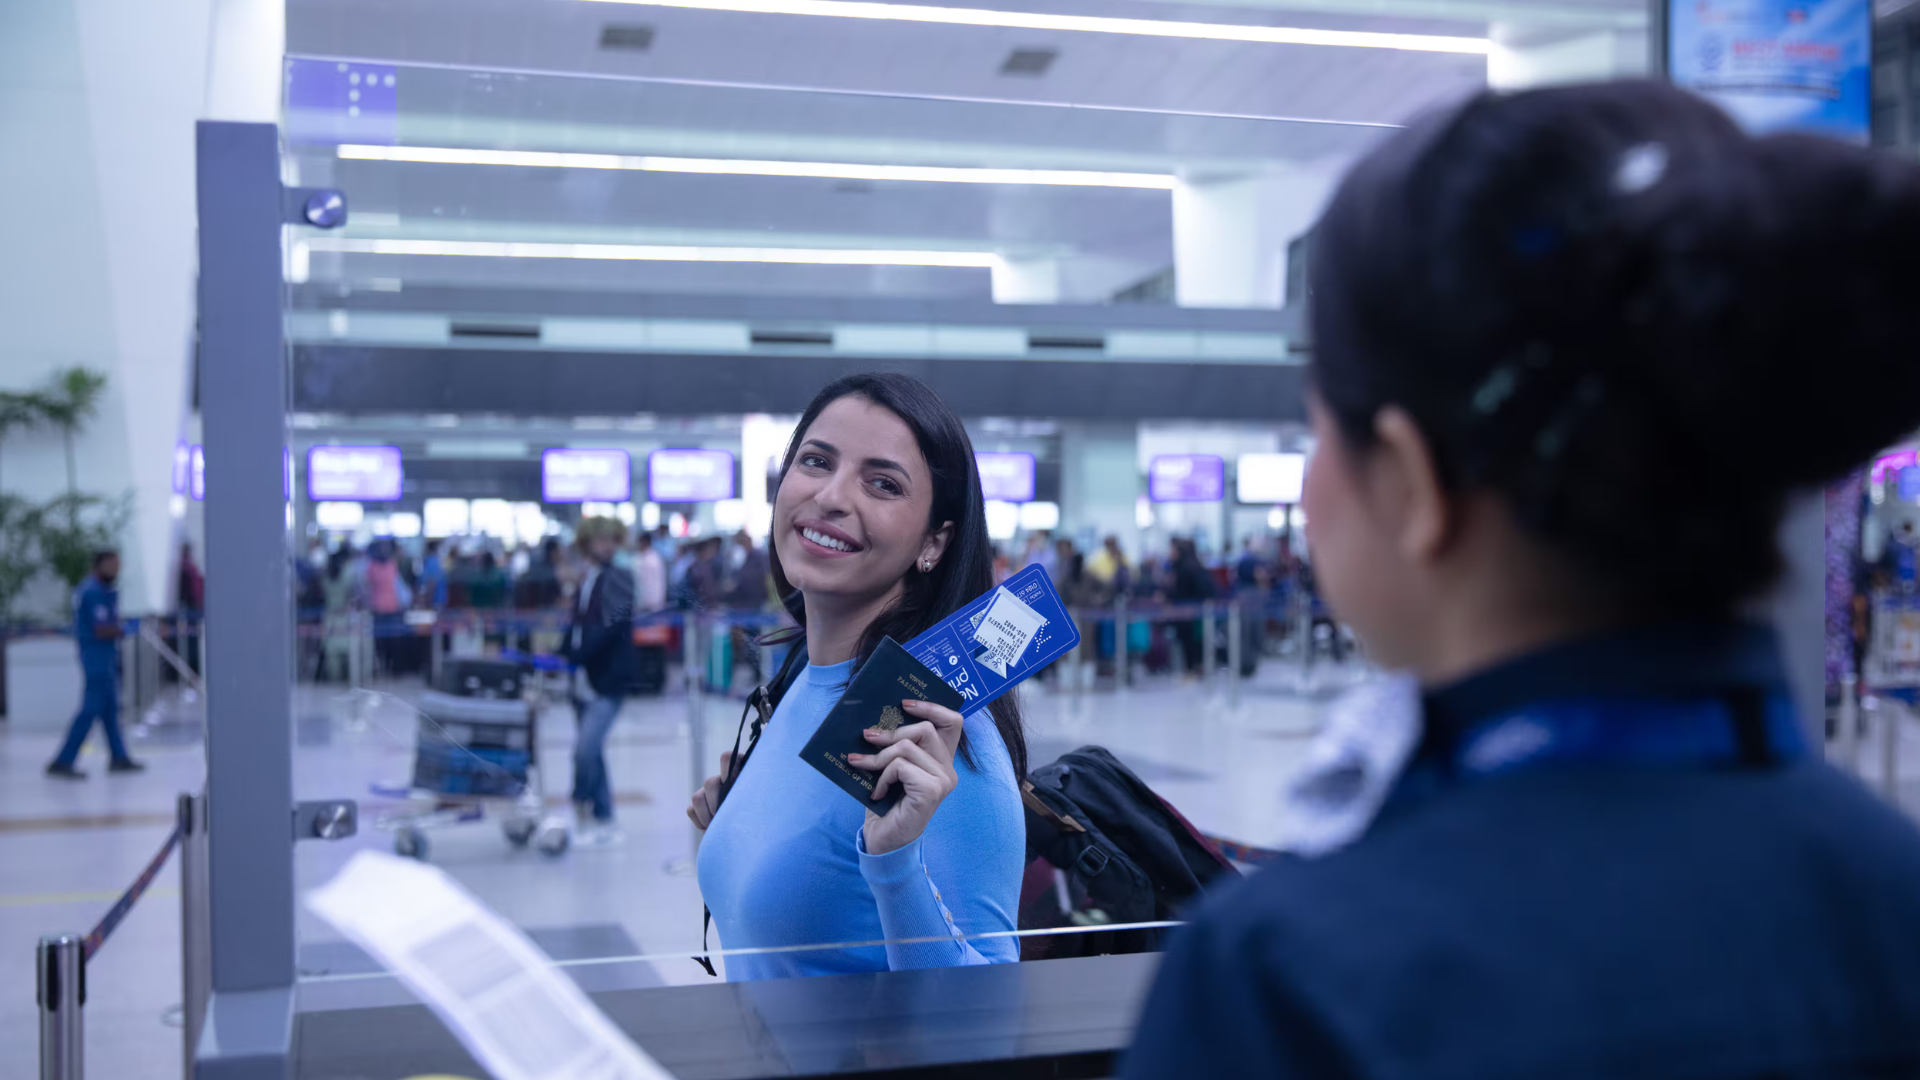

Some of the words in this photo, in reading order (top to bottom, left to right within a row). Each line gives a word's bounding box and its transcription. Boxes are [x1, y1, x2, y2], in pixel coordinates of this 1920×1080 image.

[896, 676, 928, 701] PASSPORT
[957, 682, 979, 701] Ne
[823, 751, 852, 775] REPUBLIC
[851, 772, 861, 782] OF
